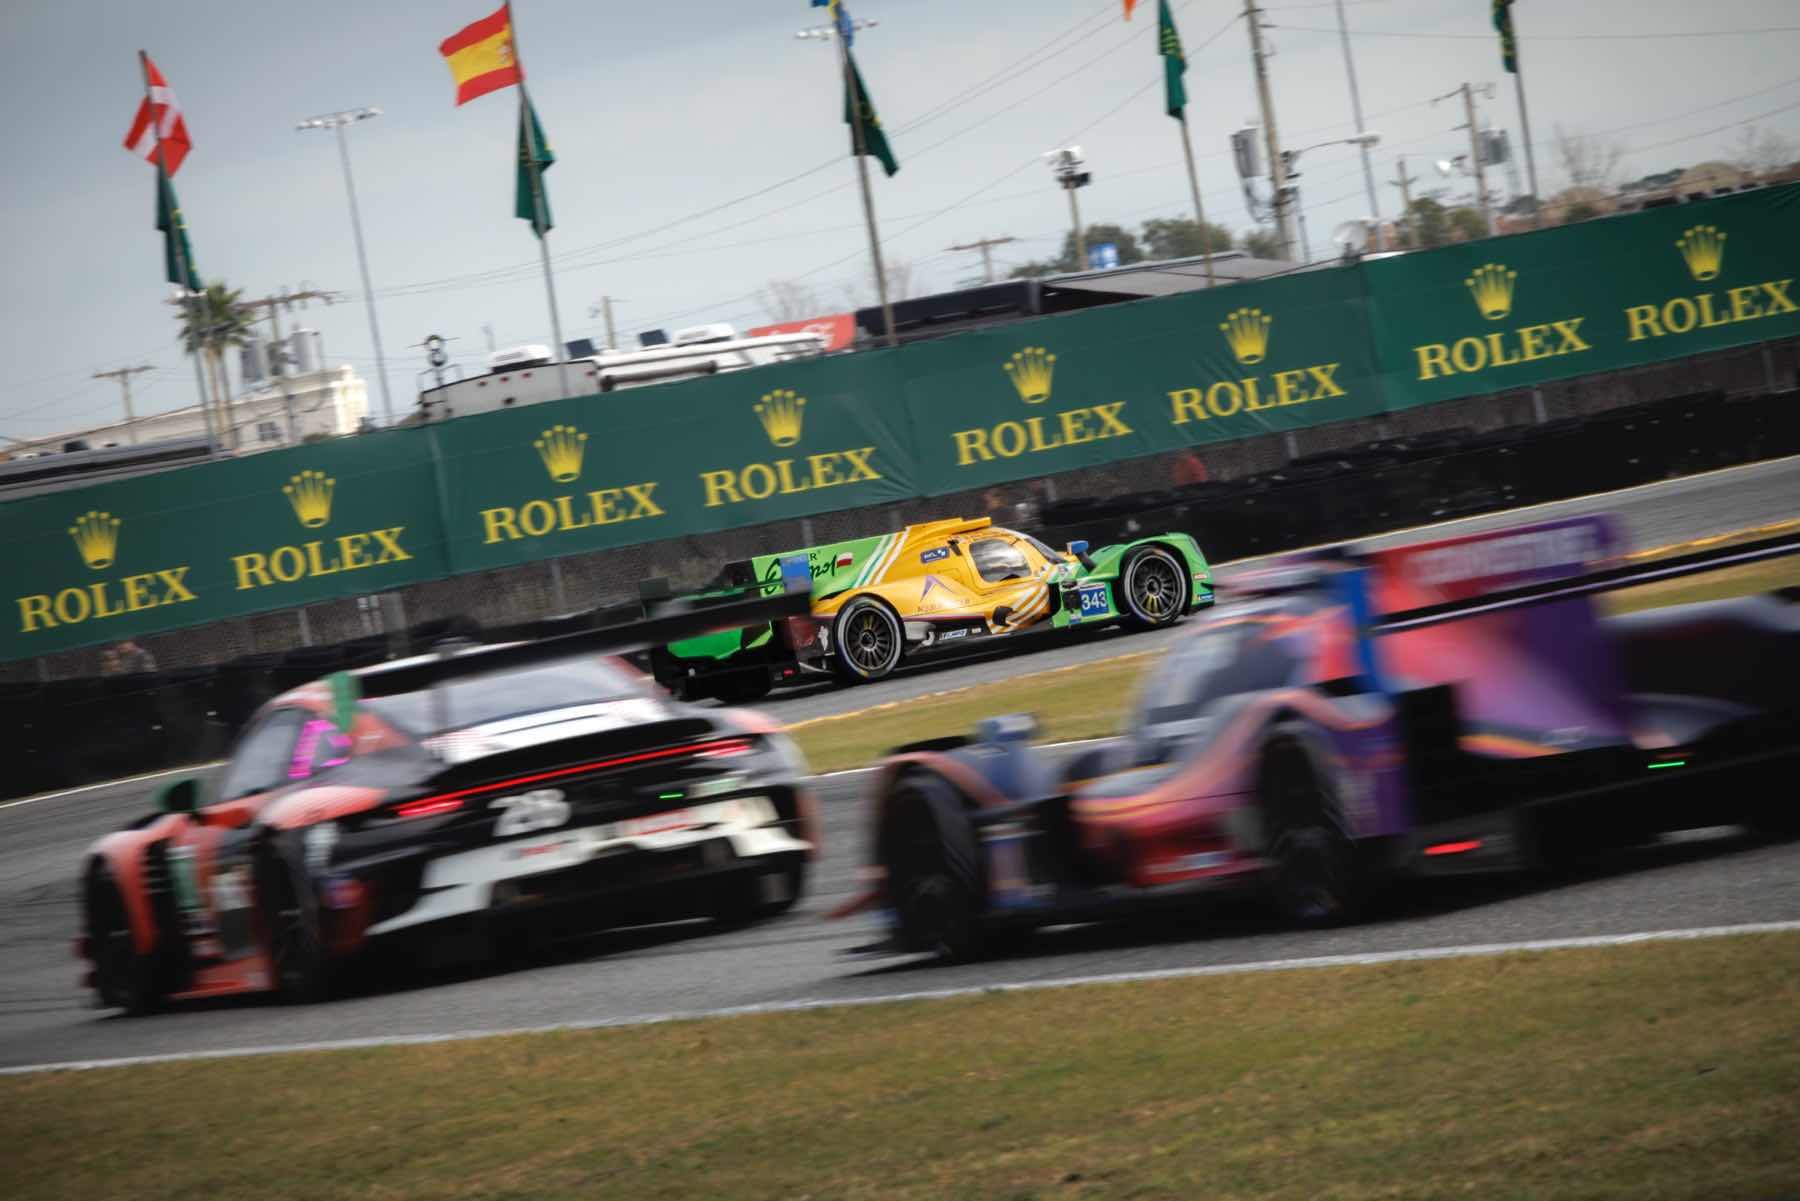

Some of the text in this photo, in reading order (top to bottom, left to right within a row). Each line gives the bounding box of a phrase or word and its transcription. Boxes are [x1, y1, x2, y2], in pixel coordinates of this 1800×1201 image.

[1626, 279, 1799, 340] ROLEX
[1414, 319, 1588, 379] ROLEX
[1168, 363, 1346, 424] ROLEX
[953, 401, 1133, 464] ROLEX
[700, 447, 883, 506] ROLEX
[481, 482, 666, 543] ROLEX
[230, 527, 411, 589] ROLEX
[17, 566, 197, 631] ROLEX
[1081, 590, 1107, 610] 343
